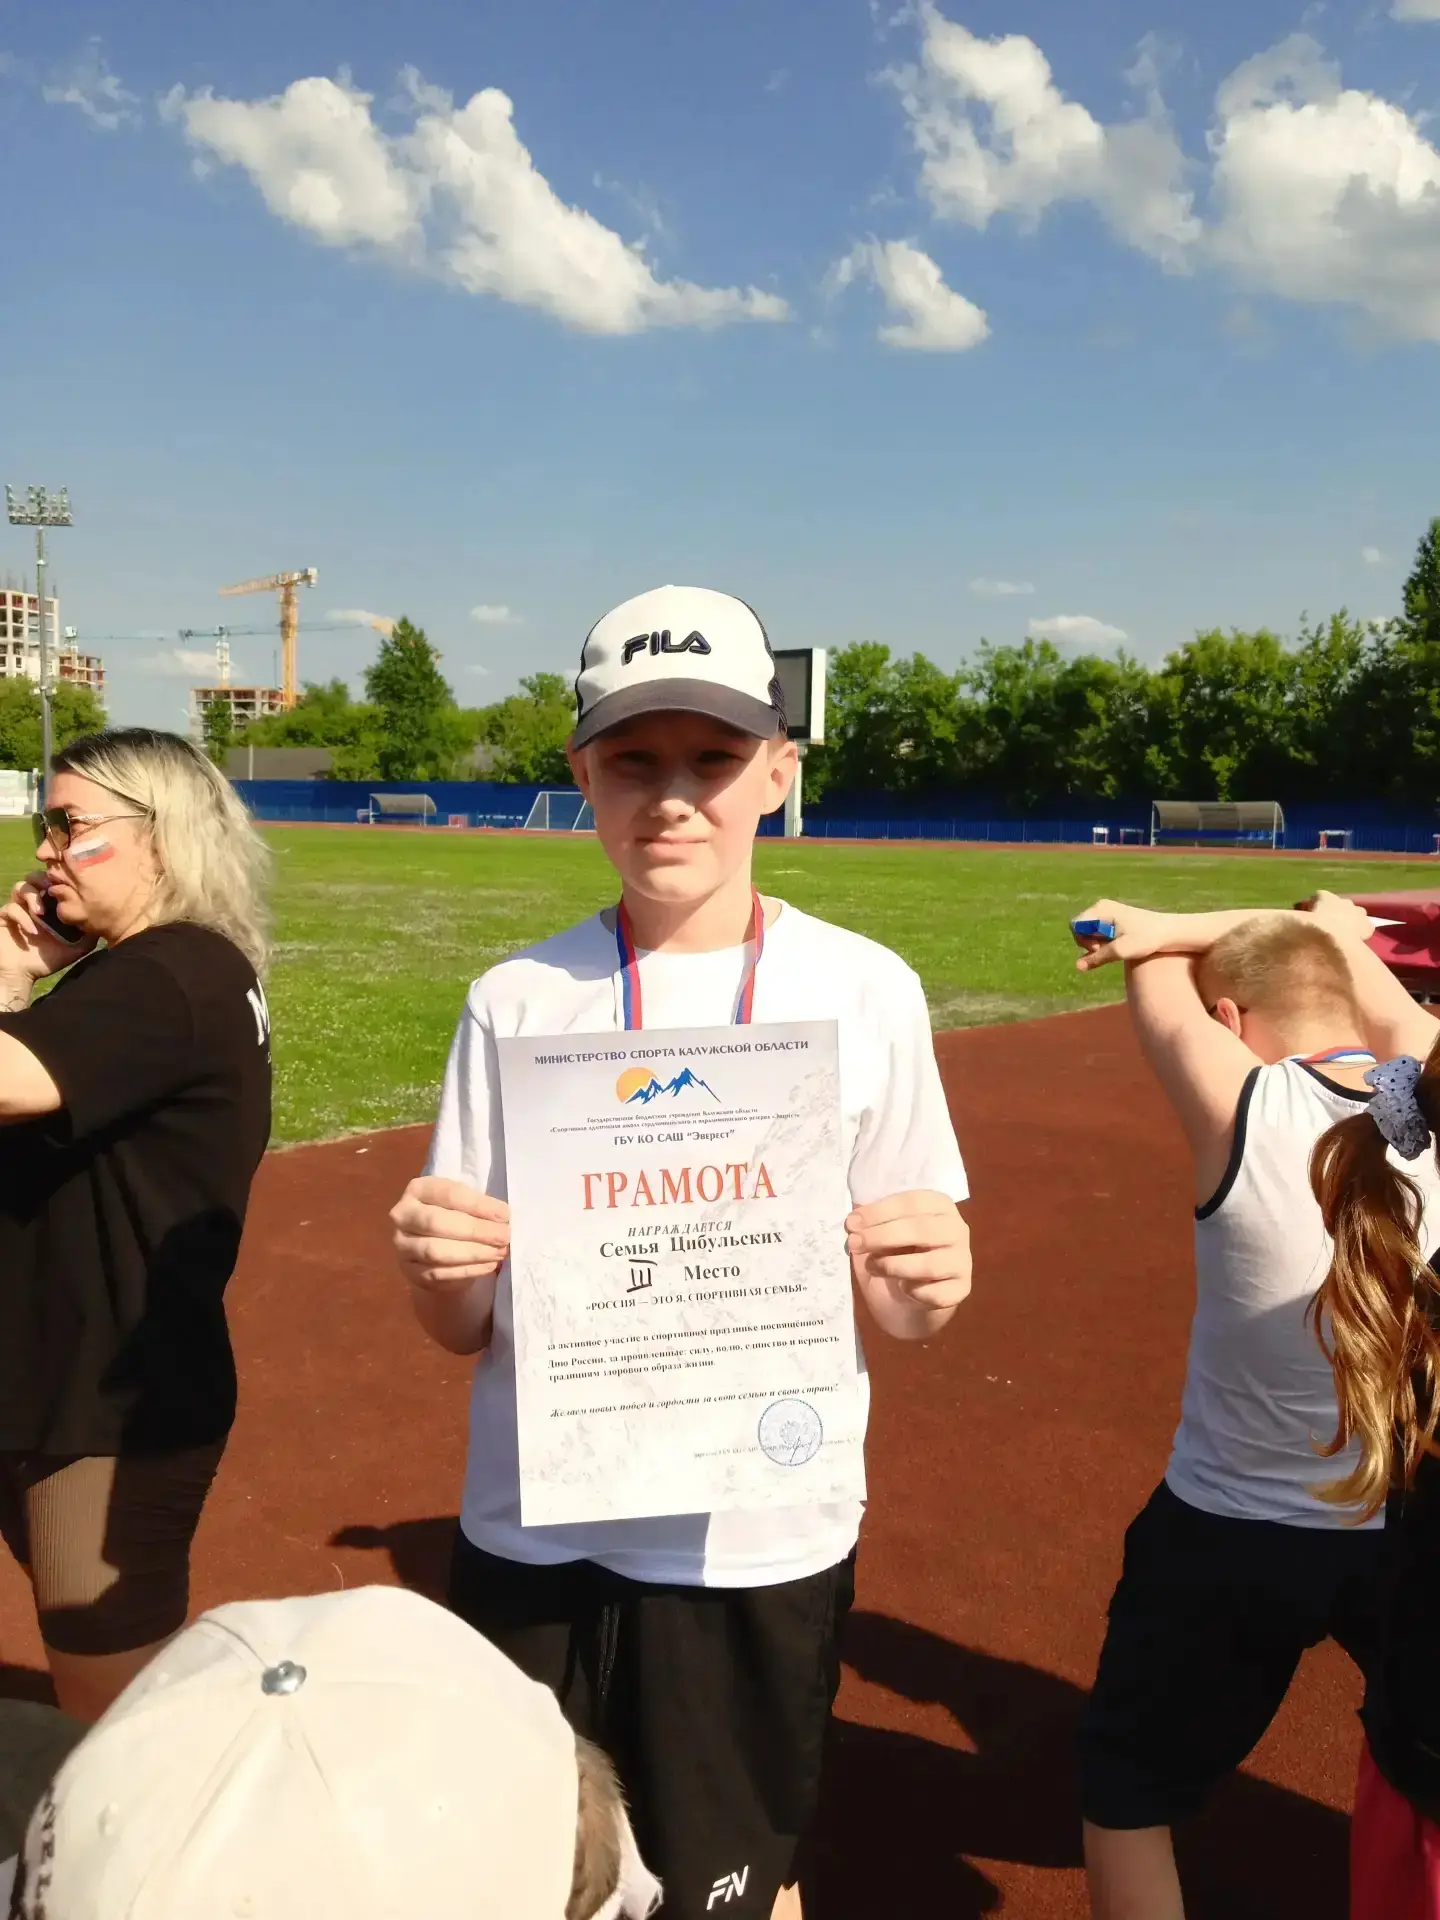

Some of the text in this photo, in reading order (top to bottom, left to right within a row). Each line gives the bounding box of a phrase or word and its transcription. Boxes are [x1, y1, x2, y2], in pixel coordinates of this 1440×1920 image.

[621, 629, 711, 666] FILA
[534, 1041, 809, 1065] МИНИСТЕРСТВО СПОРТА КАЛУЖСКОЙ ОБЛАСТИ
[613, 1135, 634, 1146] ГБУ
[637, 1134, 654, 1144] КО
[657, 1132, 684, 1143] САШ
[581, 1161, 778, 1210] ГРАМОТА
[628, 1220, 733, 1238] НАГРАЖДАЕТСЯ
[599, 1230, 783, 1258] Семья Цибульских
[684, 1264, 741, 1282] Место
[586, 1298, 636, 1311] «РОССИЯ
[652, 1294, 673, 1305] ЭТО
[688, 1287, 762, 1302] СПОРТИВНАЯ
[764, 1283, 808, 1296] СЕМЬЯ»
[558, 1340, 601, 1350] активное
[604, 1336, 641, 1347] участие
[651, 1328, 708, 1341] спортивном
[798, 1335, 840, 1347] верность
[603, 1366, 649, 1378] здорового
[651, 1362, 682, 1373] образа
[589, 1405, 617, 1414] новых
[738, 1390, 767, 1400] семью
[777, 1387, 800, 1396] свою
